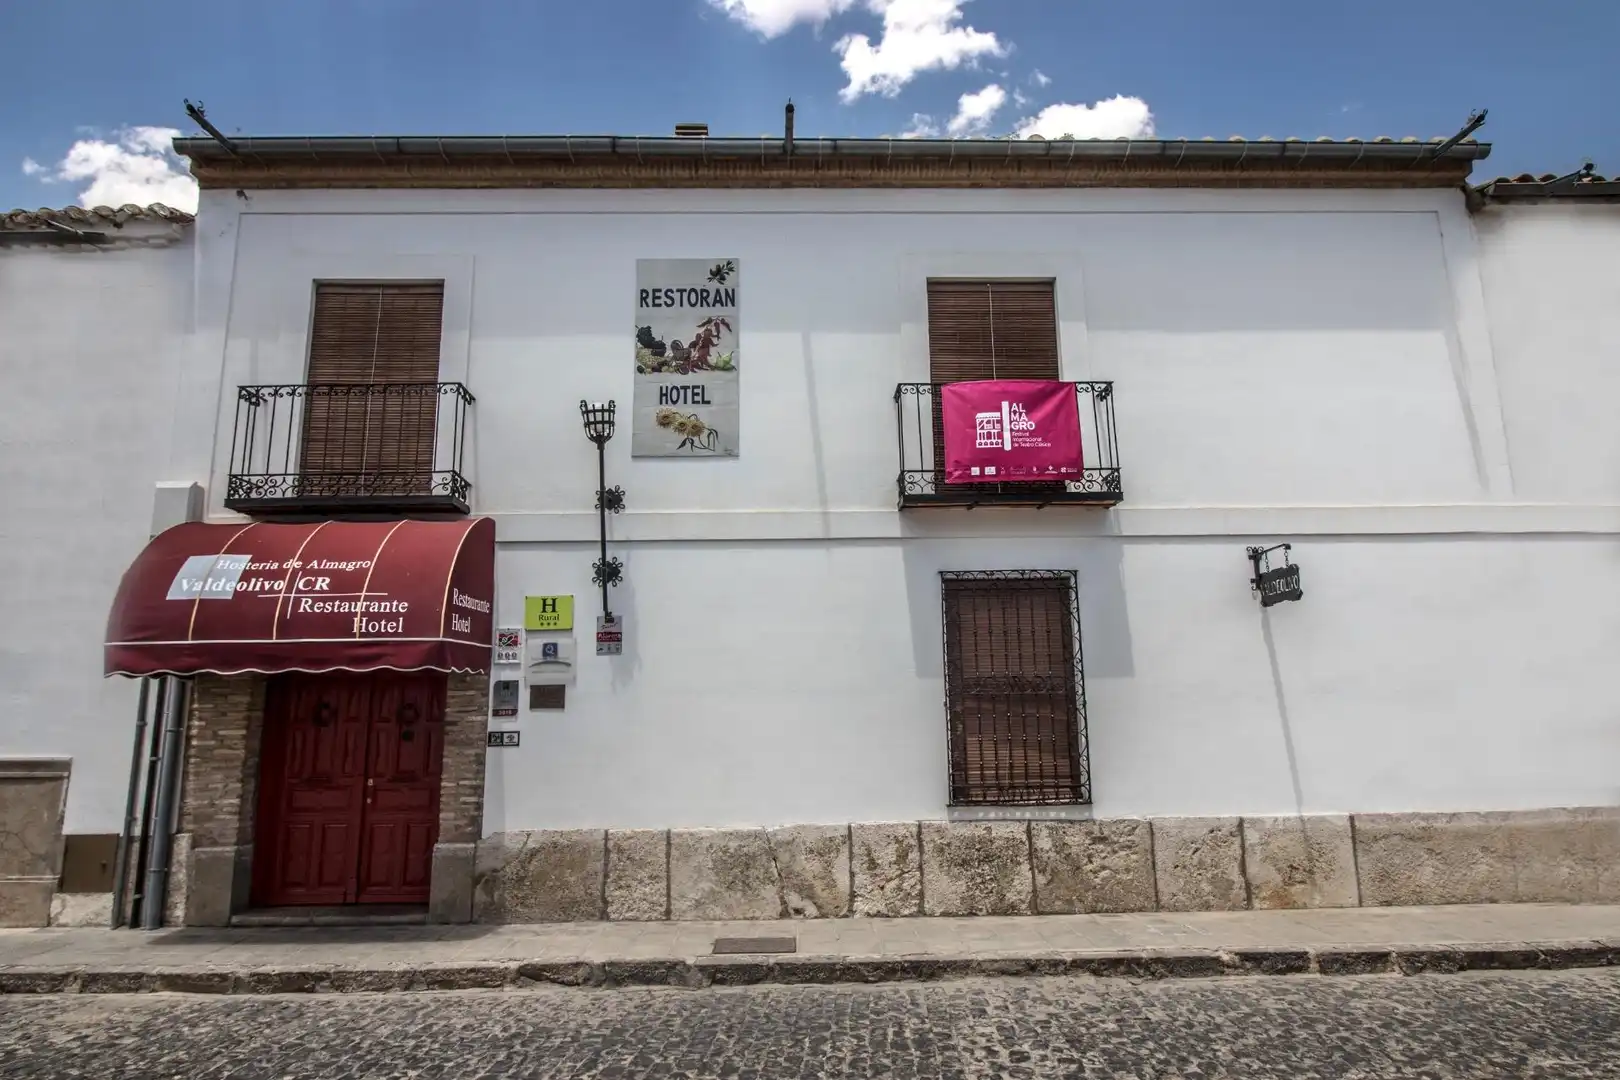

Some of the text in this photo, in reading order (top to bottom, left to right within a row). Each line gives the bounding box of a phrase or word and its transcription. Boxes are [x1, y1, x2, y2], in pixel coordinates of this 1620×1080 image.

[639, 288, 736, 308] RESTORAN
[659, 385, 711, 405] HOTEL
[1011, 403, 1026, 412] AL
[1011, 412, 1028, 421] MA
[1011, 421, 1036, 431] GRO
[216, 558, 372, 572] Hosteria de Almagro
[181, 576, 330, 593] Valdeolivo CR
[298, 598, 408, 613] Restaurante
[452, 587, 490, 614] Restaurante
[541, 597, 558, 613] H
[451, 613, 471, 634] Hotel
[538, 613, 560, 622] Rural
[352, 618, 404, 634] Hotel
